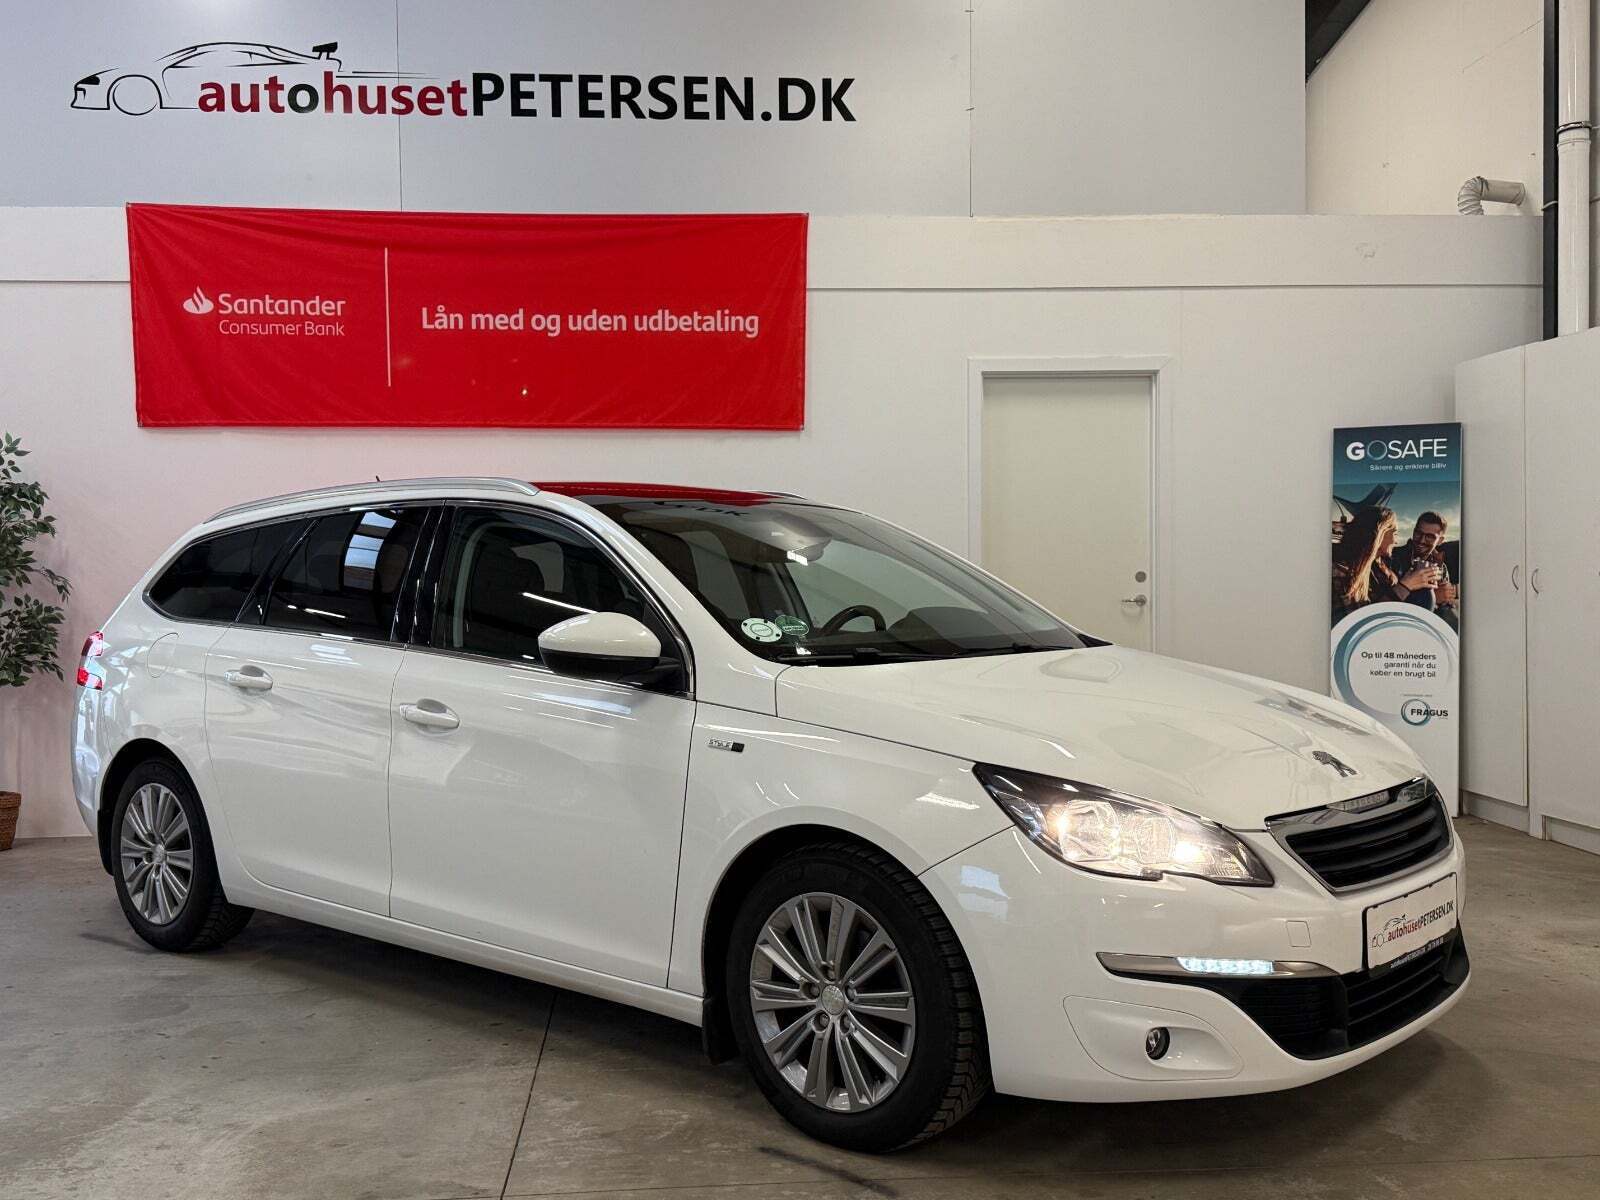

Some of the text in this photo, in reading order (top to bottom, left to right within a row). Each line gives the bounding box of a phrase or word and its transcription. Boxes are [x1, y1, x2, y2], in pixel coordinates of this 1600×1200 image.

[198, 71, 856, 122] autohusetPETERSEN.DK
[218, 293, 346, 316] Santander
[219, 320, 345, 336] Consumer Bank
[422, 305, 759, 338] Lån med og uden udbetaling
[1346, 438, 1447, 461] GOSAFE
[1361, 651, 1373, 659] Op
[1397, 652, 1437, 660] måneders
[1410, 708, 1449, 717] FRAGUS
